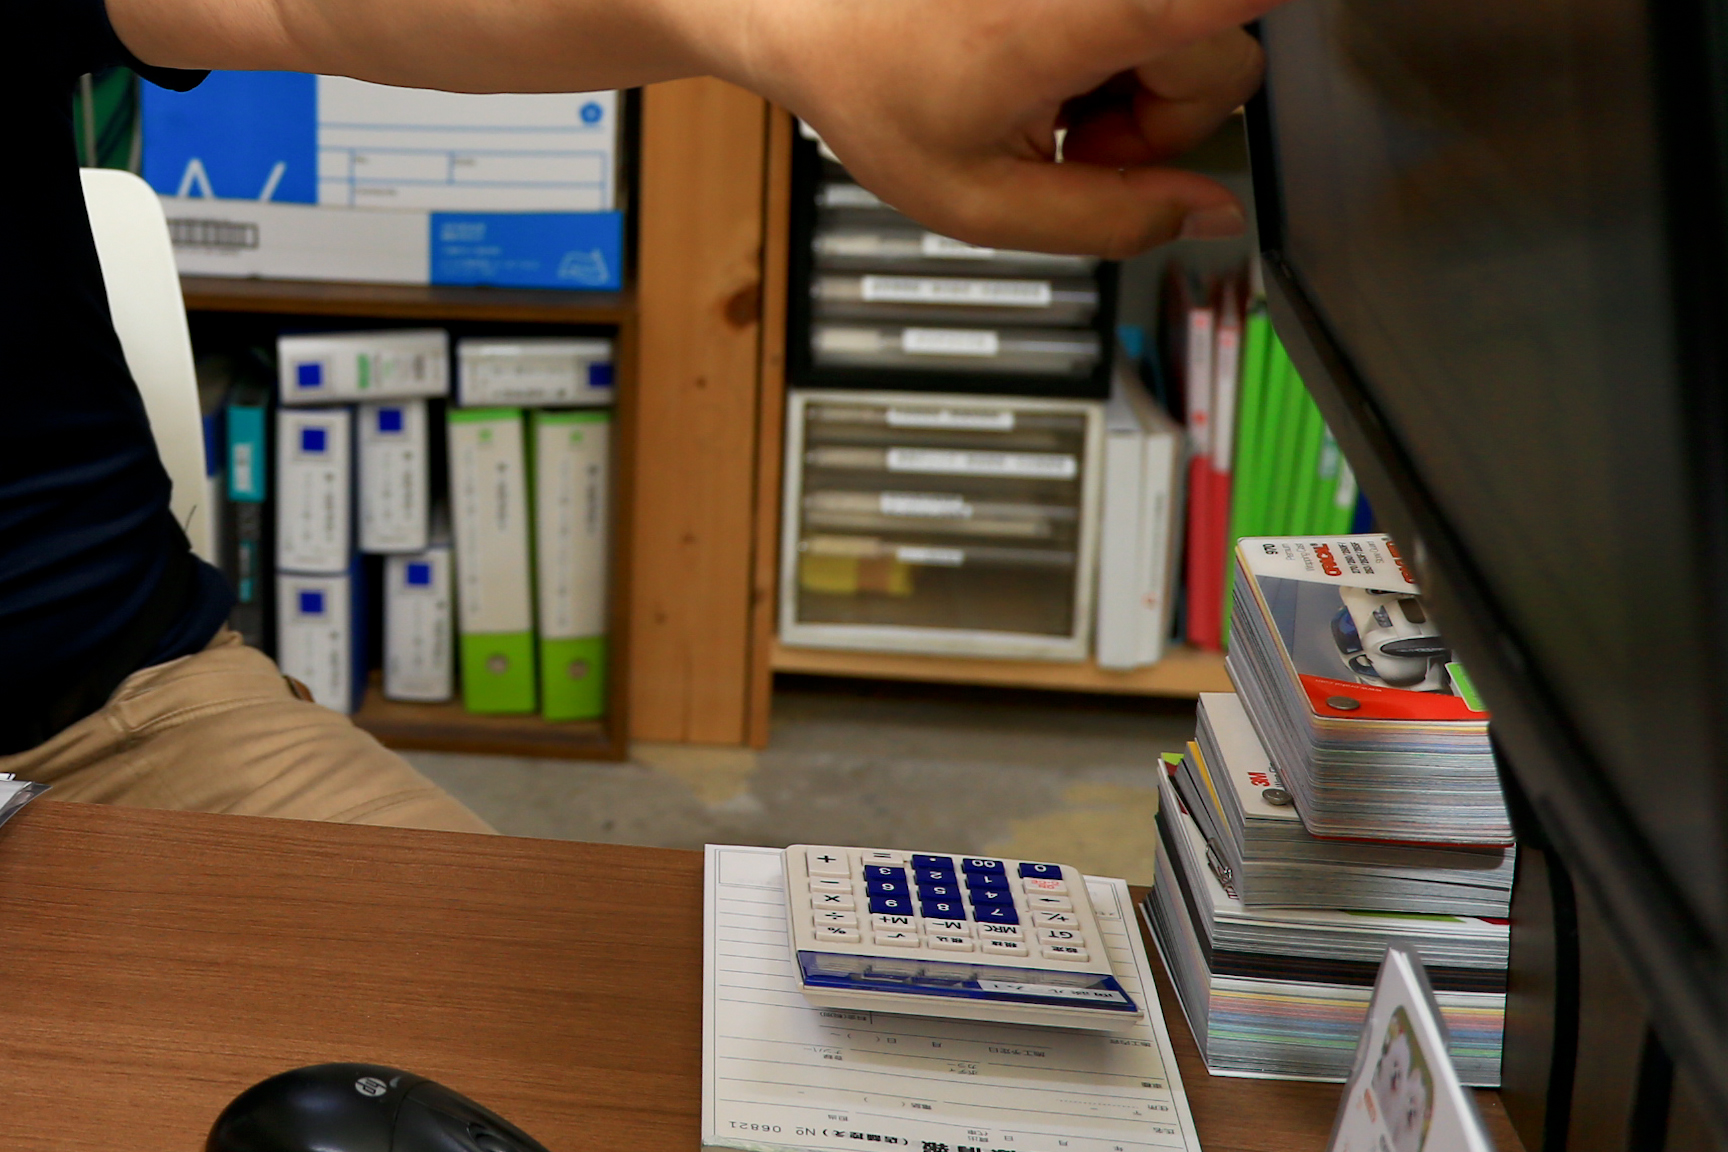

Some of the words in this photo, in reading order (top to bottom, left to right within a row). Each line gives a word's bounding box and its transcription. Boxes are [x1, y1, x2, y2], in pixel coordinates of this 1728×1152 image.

[1263, 543, 1278, 555] 970
[1247, 772, 1270, 787] 3M
[879, 866, 892, 875] 3
[930, 871, 943, 879] 2
[983, 875, 992, 884] 1
[1035, 864, 1047, 873] 0
[881, 883, 894, 891] 6
[933, 887, 946, 895] 5
[985, 891, 999, 899] 4
[885, 899, 898, 908] 9
[937, 903, 950, 912] 8
[991, 908, 1004, 916] 7
[879, 915, 908, 925] M+
[984, 924, 1017, 934] MRC
[1046, 930, 1074, 939] GT
[729, 1121, 782, 1134] 06821
